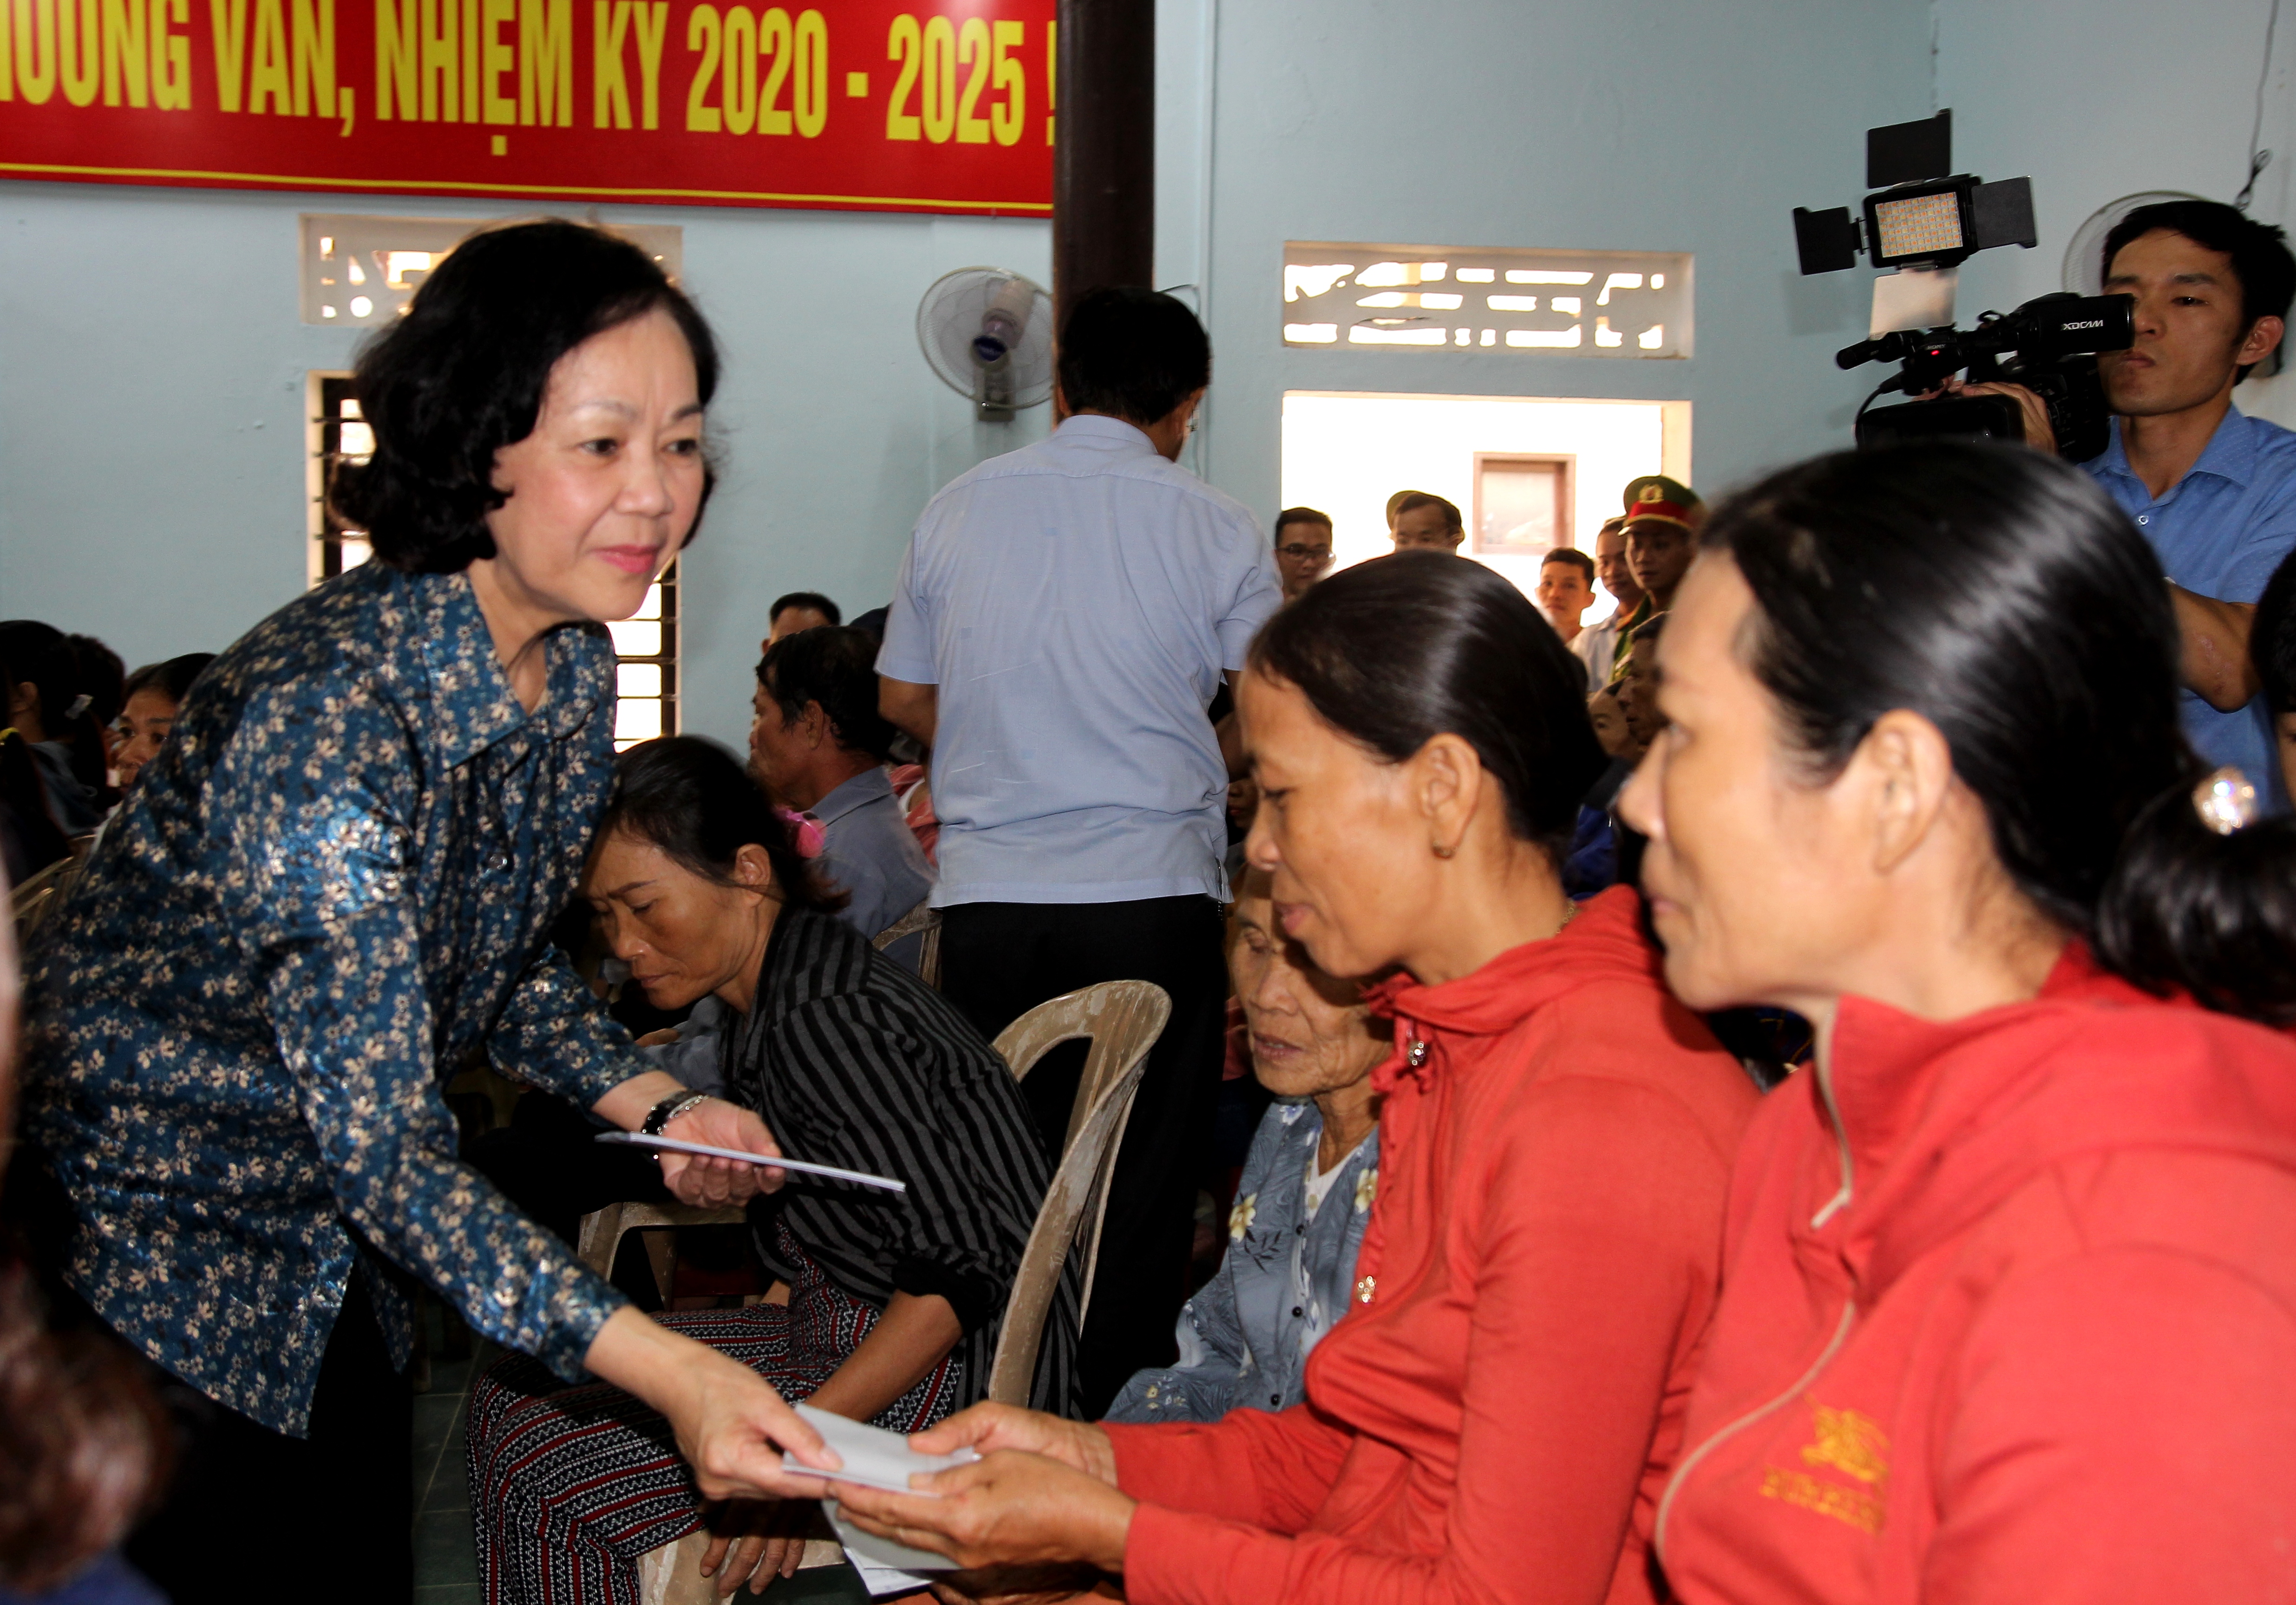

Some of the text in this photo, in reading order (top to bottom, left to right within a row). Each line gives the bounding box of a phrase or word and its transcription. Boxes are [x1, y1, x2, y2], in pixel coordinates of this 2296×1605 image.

[686, 4, 828, 138] 2020
[846, 72, 869, 98] -
[886, 13, 1026, 147] 2025
[2061, 320, 2104, 331] XDCAM
